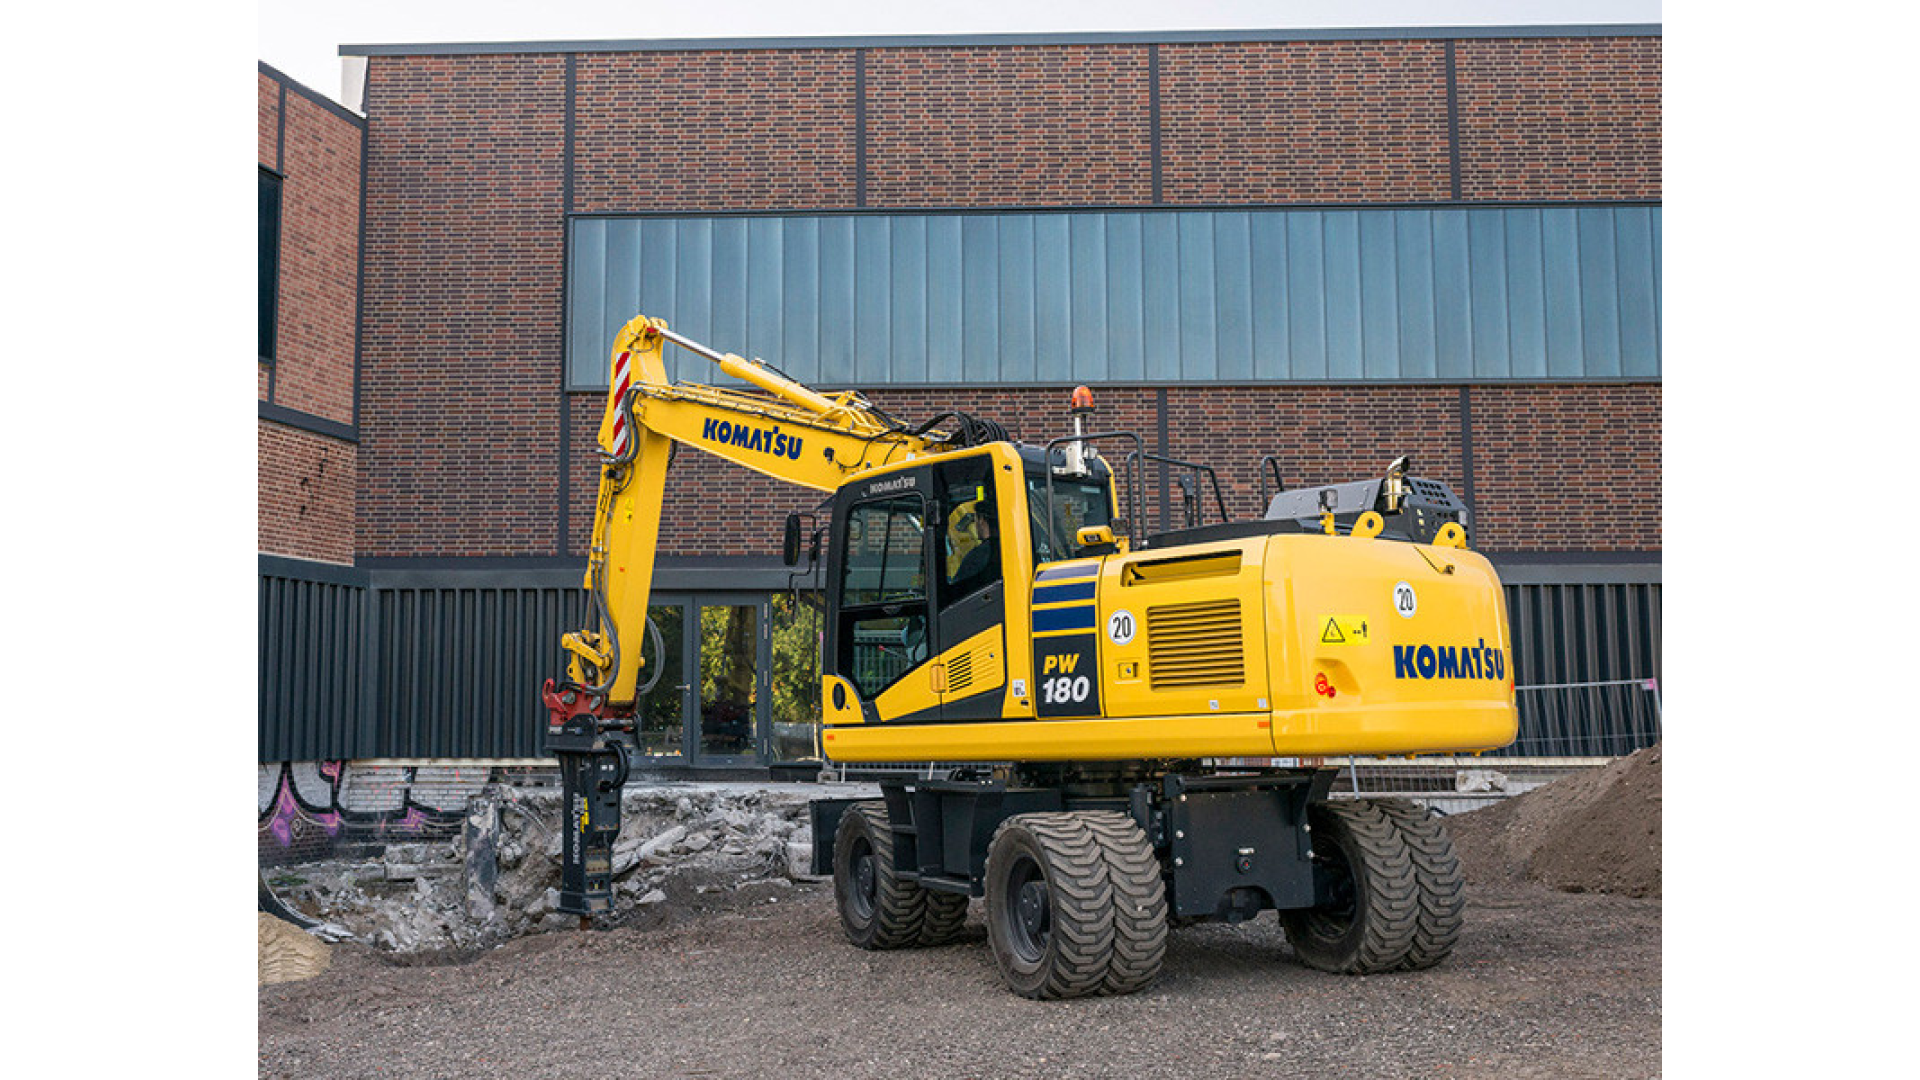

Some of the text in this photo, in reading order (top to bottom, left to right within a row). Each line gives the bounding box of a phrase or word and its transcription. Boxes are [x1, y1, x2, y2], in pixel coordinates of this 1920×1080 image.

[702, 417, 804, 461] KOMATSU
[869, 475, 916, 494] KOMATSU
[1396, 587, 1414, 611] 20
[1112, 615, 1133, 639] 20
[1042, 653, 1080, 676] PW
[1393, 637, 1505, 681] KOMATSU
[1042, 675, 1091, 704] 180
